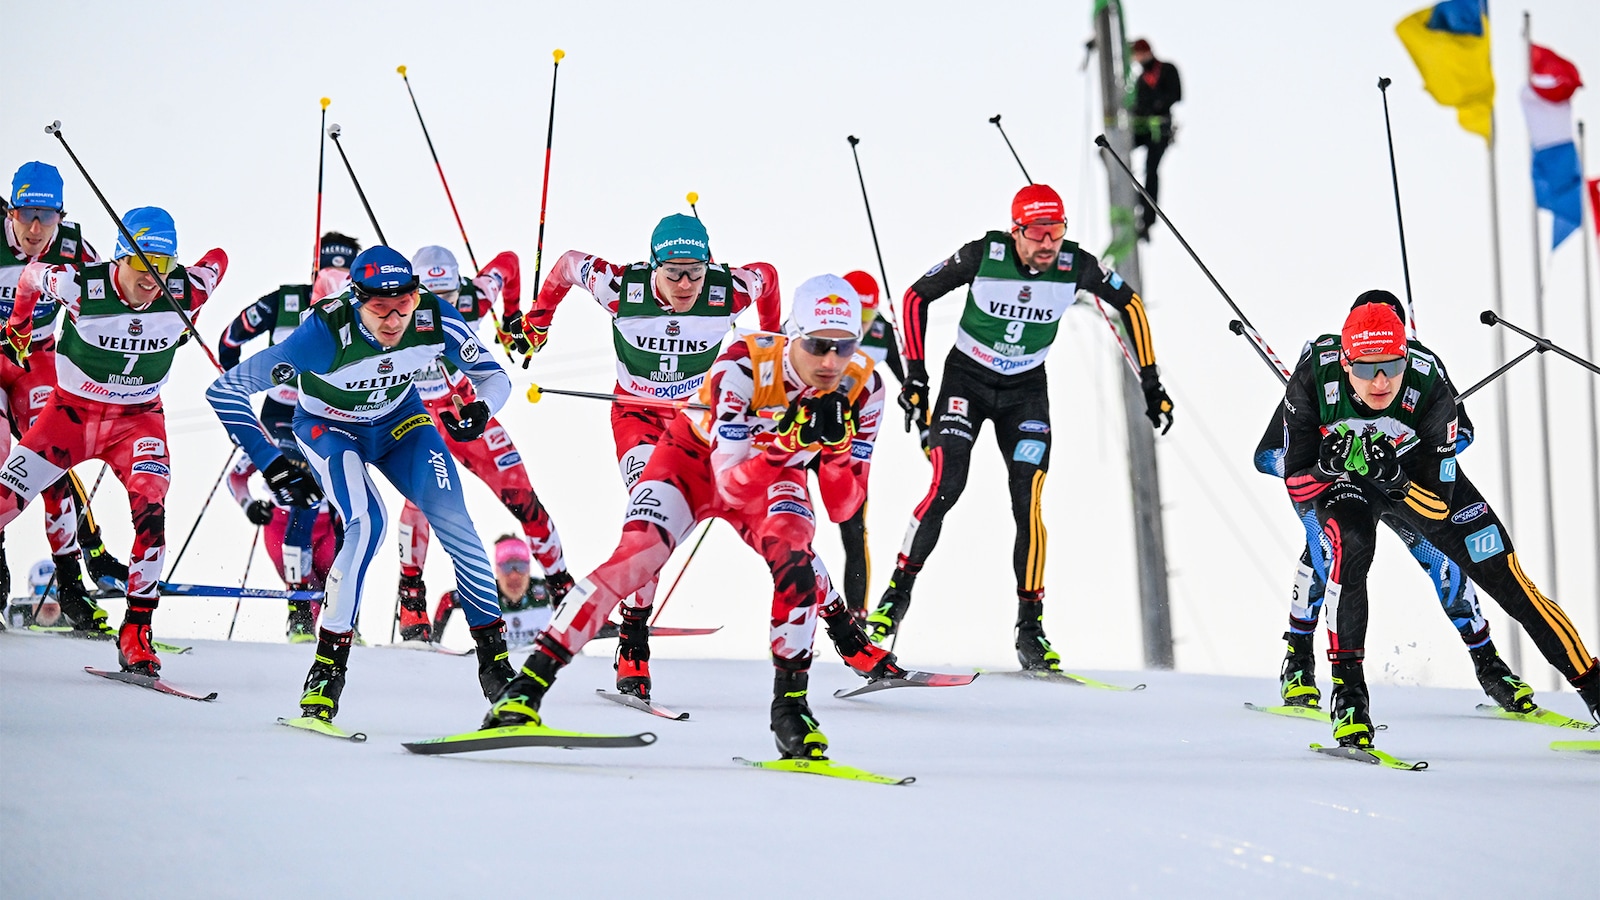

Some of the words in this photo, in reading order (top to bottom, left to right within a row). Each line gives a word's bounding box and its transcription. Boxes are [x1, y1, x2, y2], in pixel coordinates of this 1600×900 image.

[815, 307, 834, 317] Red
[836, 307, 852, 318] Bull
[990, 301, 1053, 321] VELTINS
[1003, 321, 1026, 344] 9
[1351, 330, 1393, 340] VIESSMANN
[98, 335, 169, 351] VELTINS
[636, 335, 708, 352] VELTINS
[121, 353, 140, 375] 7
[366, 387, 389, 403] 4
[393, 416, 432, 437] DIMEX
[1020, 442, 1041, 461] TQ
[1454, 504, 1484, 520] personal
[1461, 511, 1479, 522] shop
[1470, 531, 1499, 553] TQ
